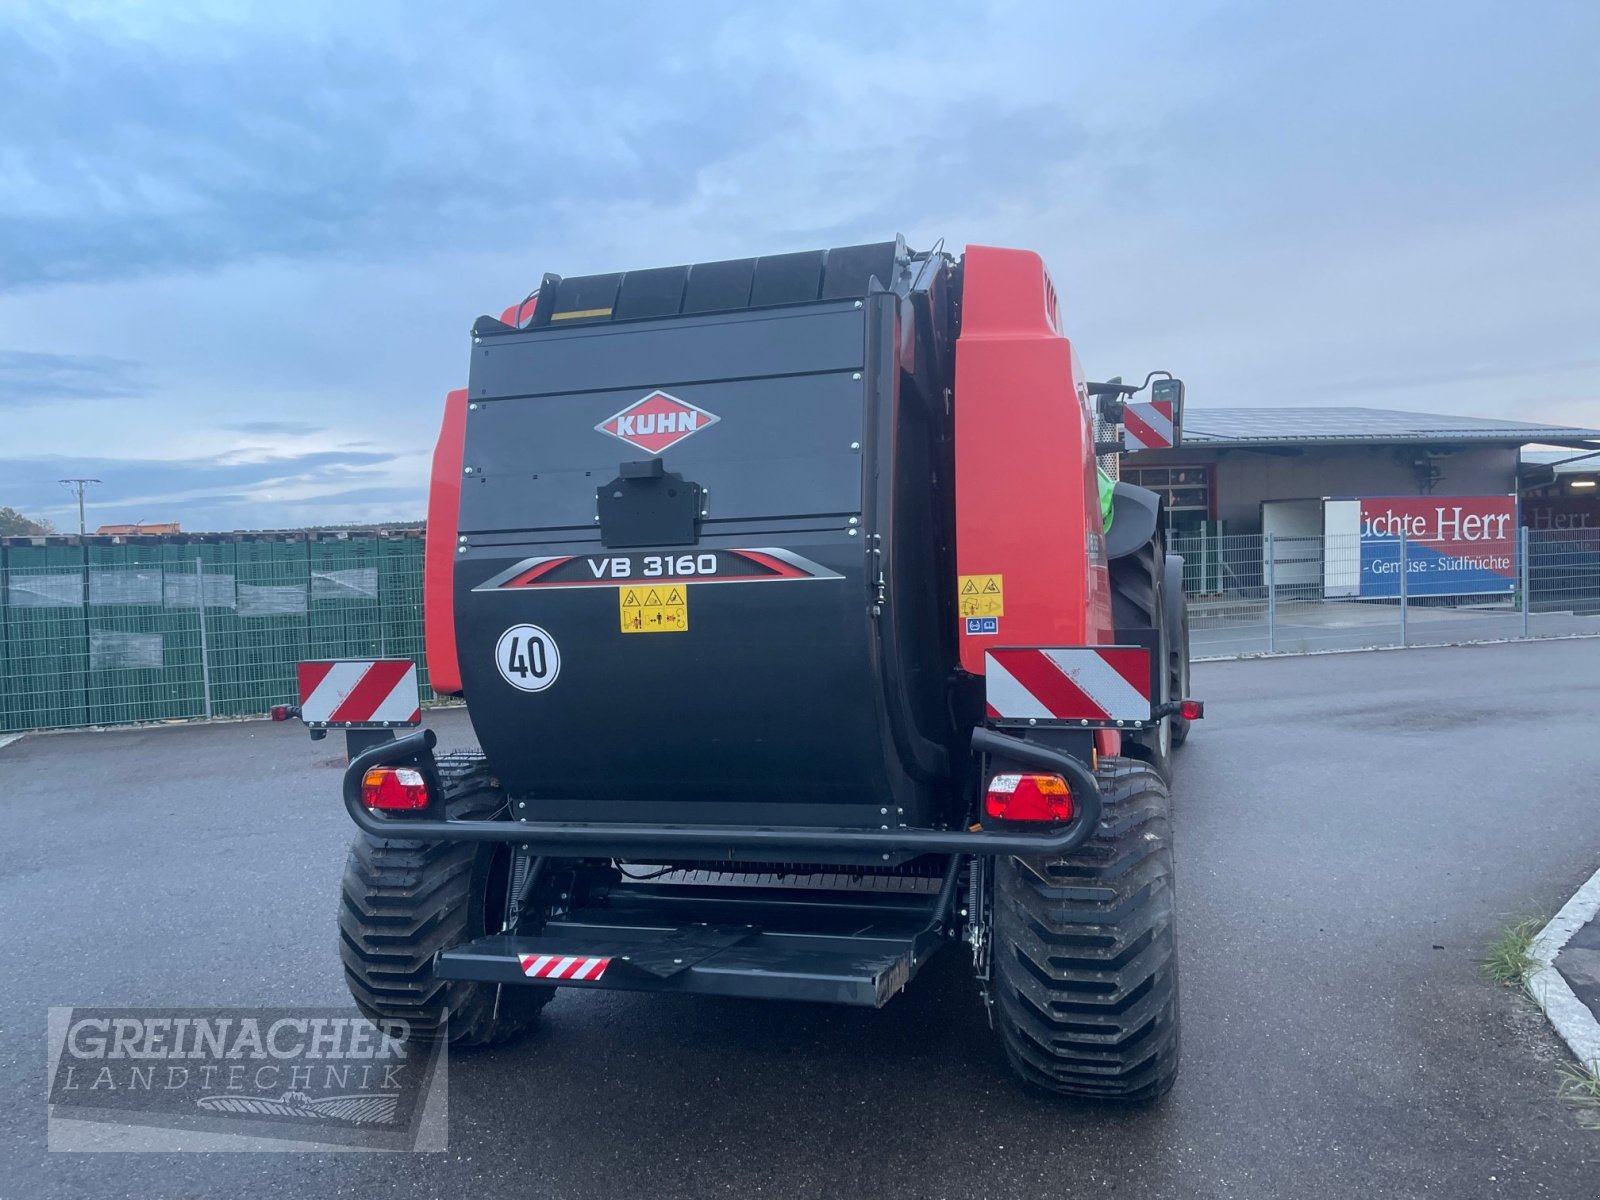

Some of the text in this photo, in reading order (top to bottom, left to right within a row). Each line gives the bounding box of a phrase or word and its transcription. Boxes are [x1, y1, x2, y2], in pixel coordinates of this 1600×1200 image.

[617, 410, 698, 437] KUHN
[1435, 507, 1510, 542] Herr
[587, 554, 718, 578] VB 3160
[1438, 556, 1510, 572] Südfrüchte
[507, 636, 548, 679] 40
